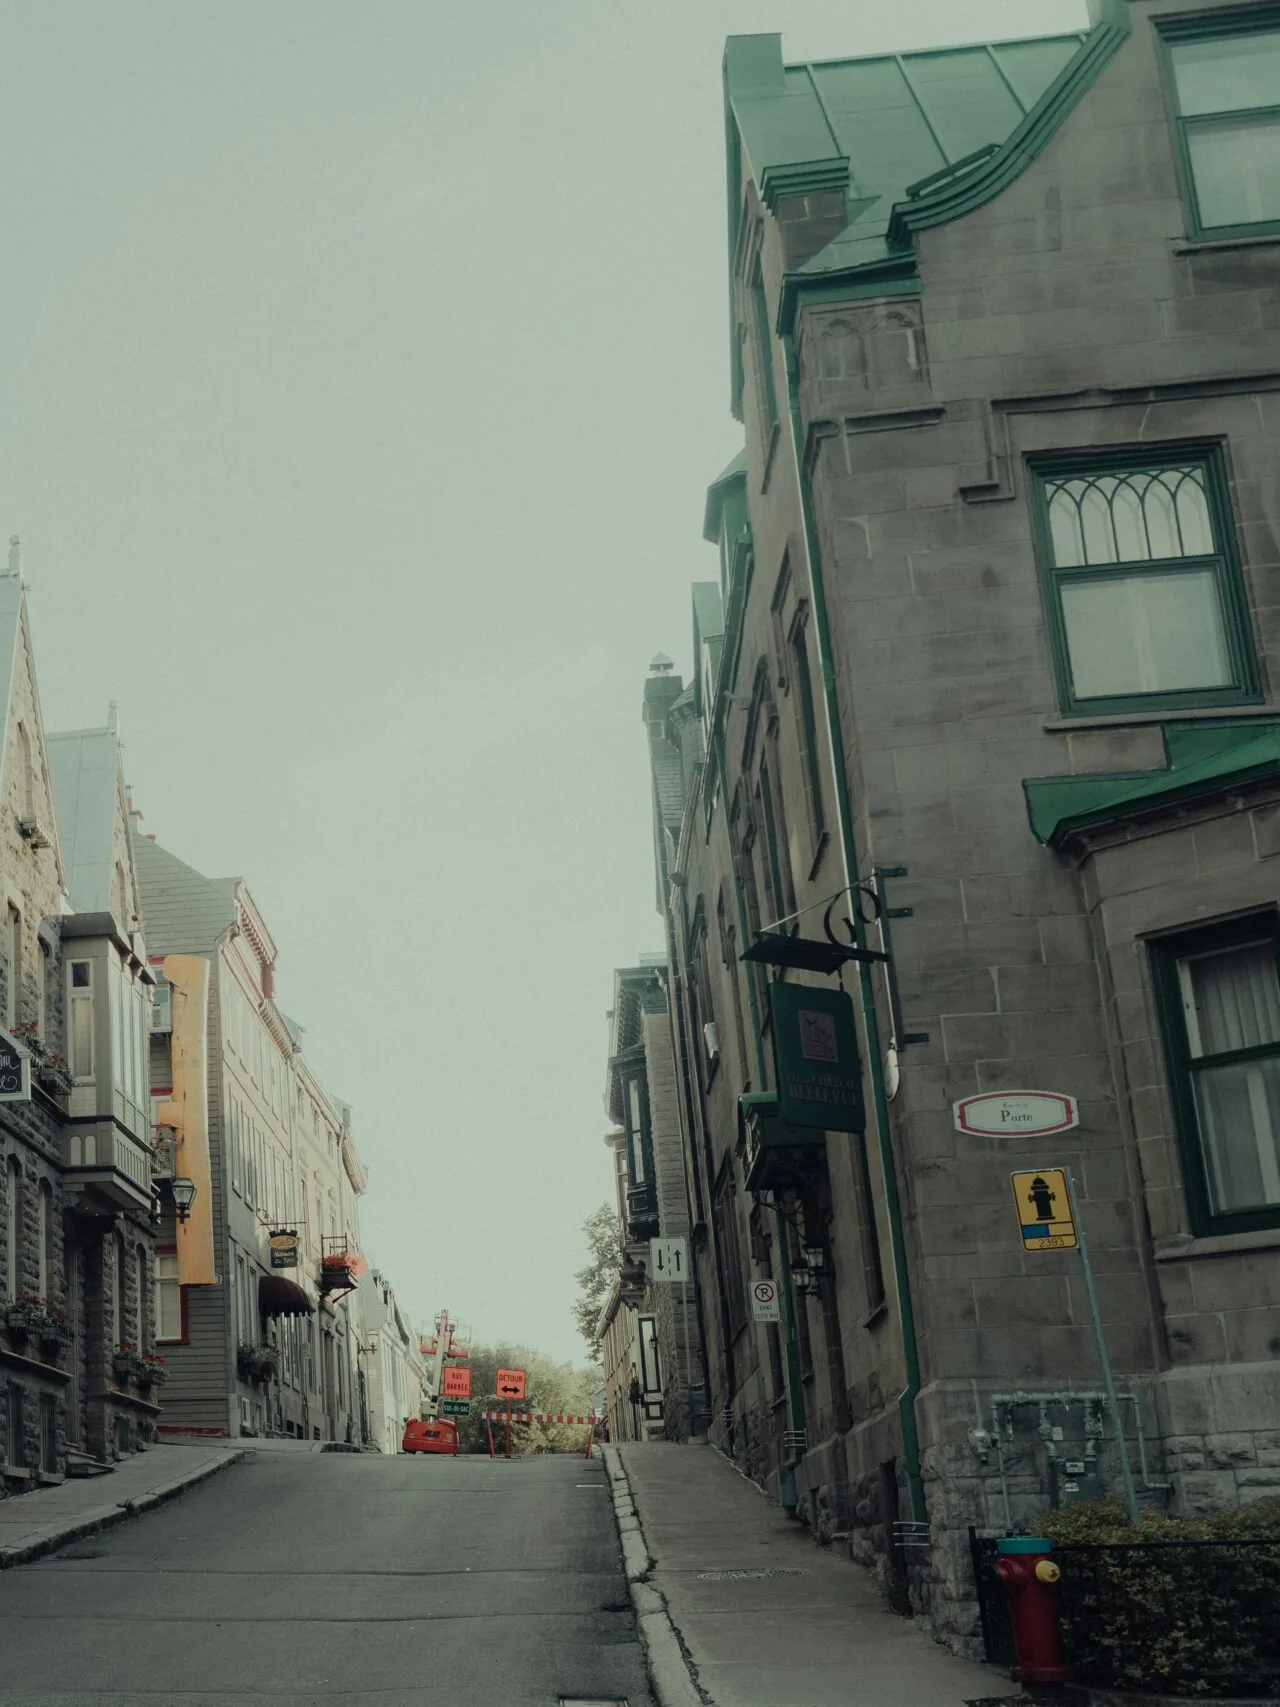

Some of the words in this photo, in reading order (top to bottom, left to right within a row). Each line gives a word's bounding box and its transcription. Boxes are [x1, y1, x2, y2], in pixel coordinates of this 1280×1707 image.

[1000, 1110, 1033, 1122] Porte
[1038, 1237, 1065, 1248] 2393
[452, 1372, 464, 1380] RUE
